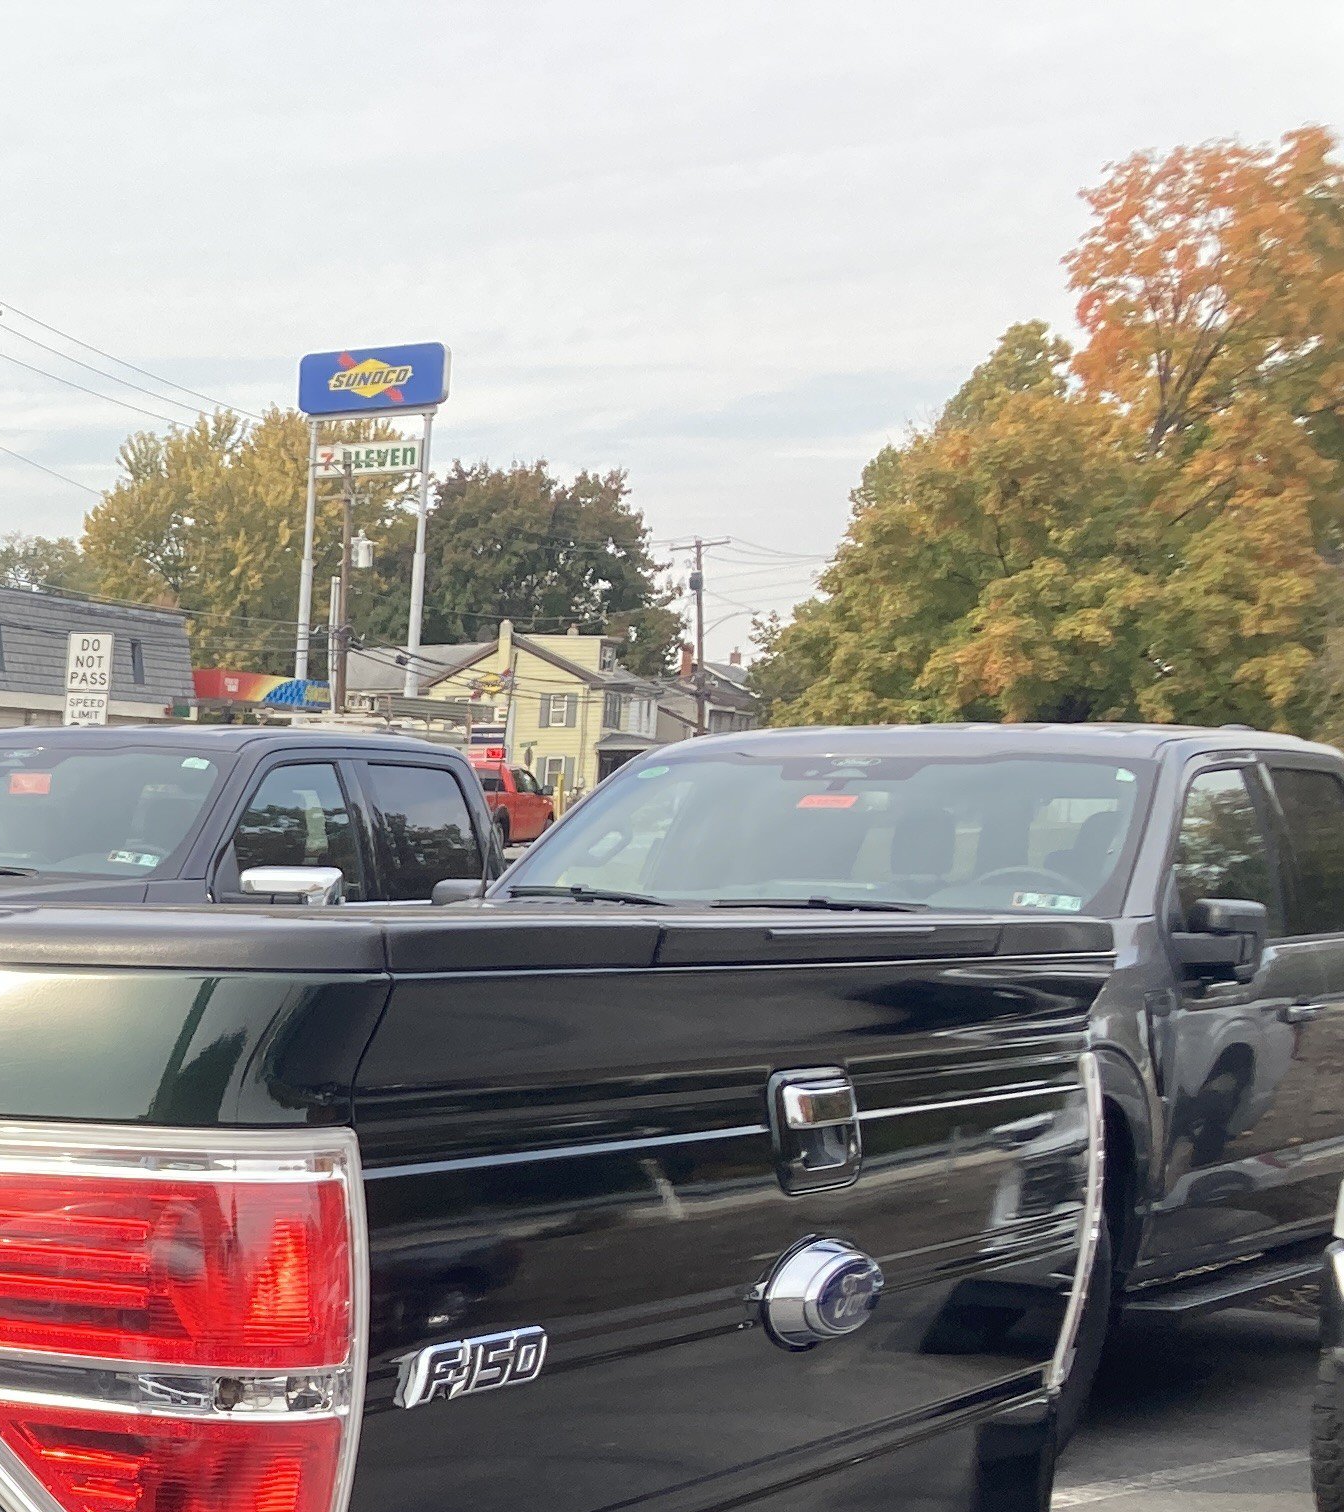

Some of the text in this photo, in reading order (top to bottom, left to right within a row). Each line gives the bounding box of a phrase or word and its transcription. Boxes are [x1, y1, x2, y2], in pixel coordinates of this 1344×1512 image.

[332, 368, 409, 388] SUNOCO
[81, 638, 101, 652] DO
[75, 655, 104, 668] NOT
[70, 671, 107, 685] PASS
[69, 698, 105, 708] SPEED
[71, 710, 100, 720] LIMIT
